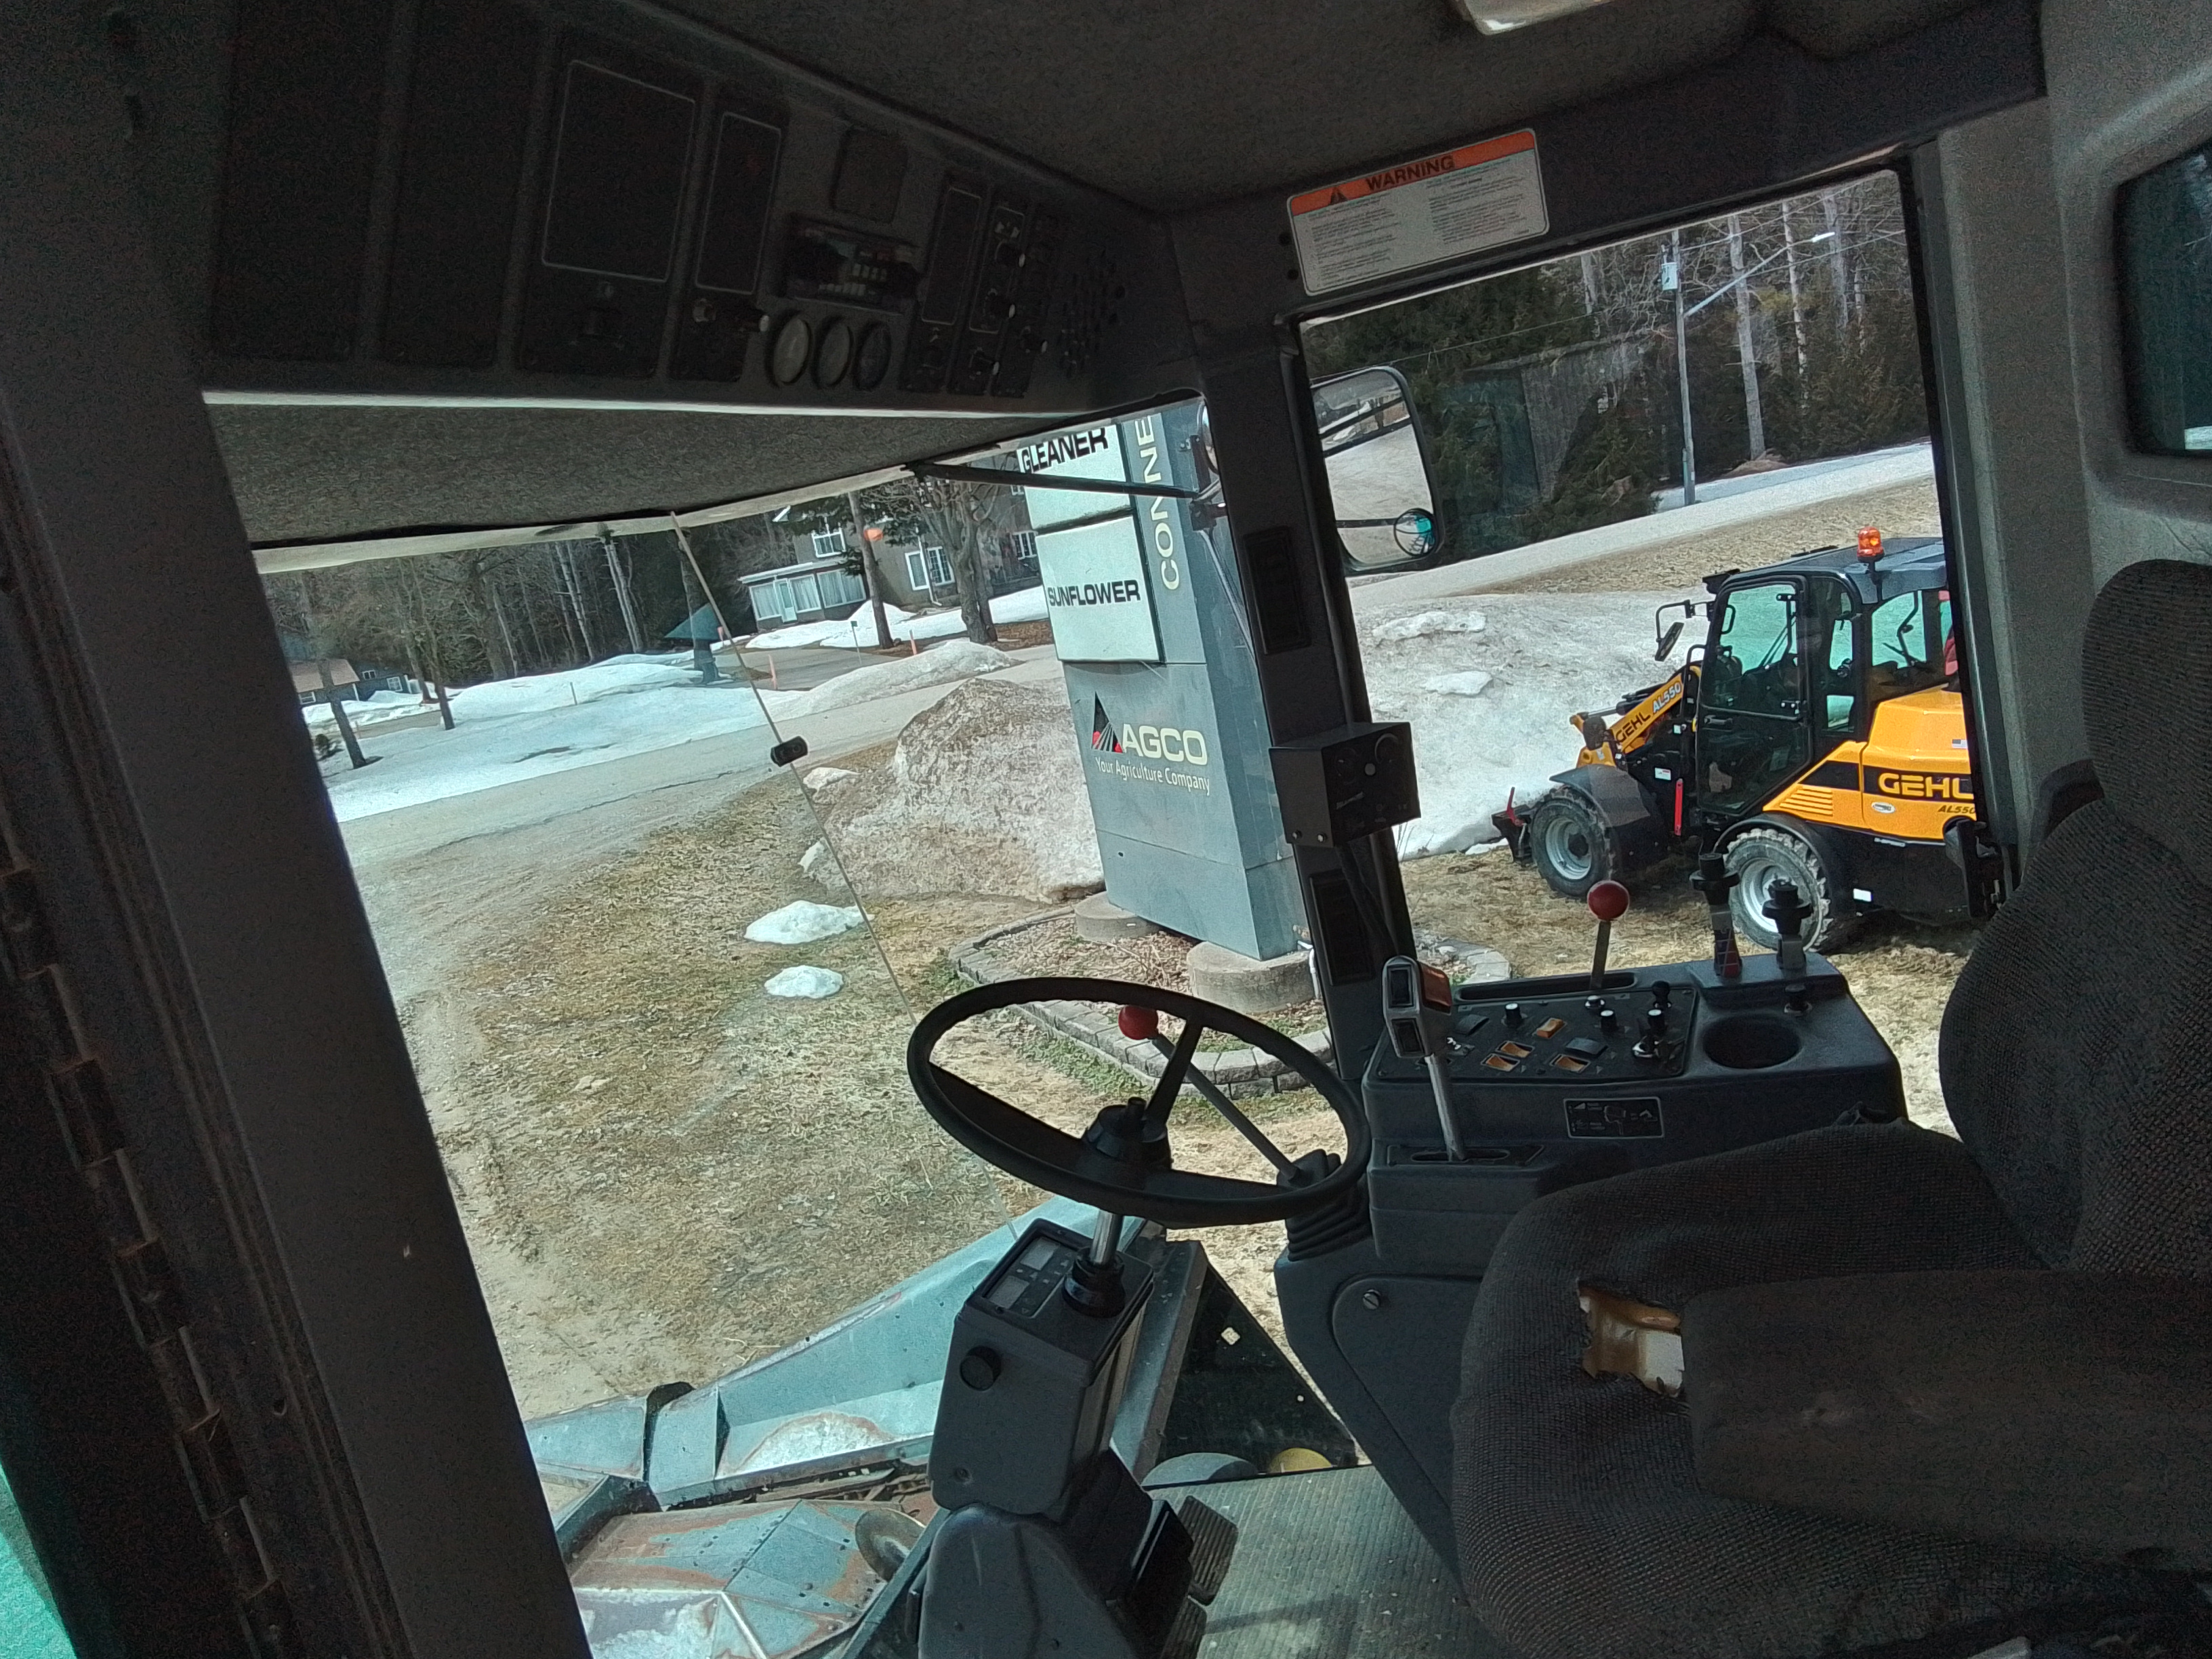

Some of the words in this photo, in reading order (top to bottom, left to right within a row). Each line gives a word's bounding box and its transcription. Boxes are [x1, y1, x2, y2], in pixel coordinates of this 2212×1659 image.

[1365, 155, 1456, 190] WARNING
[1021, 427, 1109, 473] GLEANER
[1048, 579, 1141, 607] SUNFLOWER
[1616, 712, 1651, 743] GEHL
[1652, 681, 1681, 714] AL550
[1122, 723, 1208, 766] AGCO
[1095, 756, 1113, 774] Your
[1115, 760, 1163, 783] Agriculture
[1164, 767, 1210, 796] Company
[1878, 772, 1975, 800] GEHL
